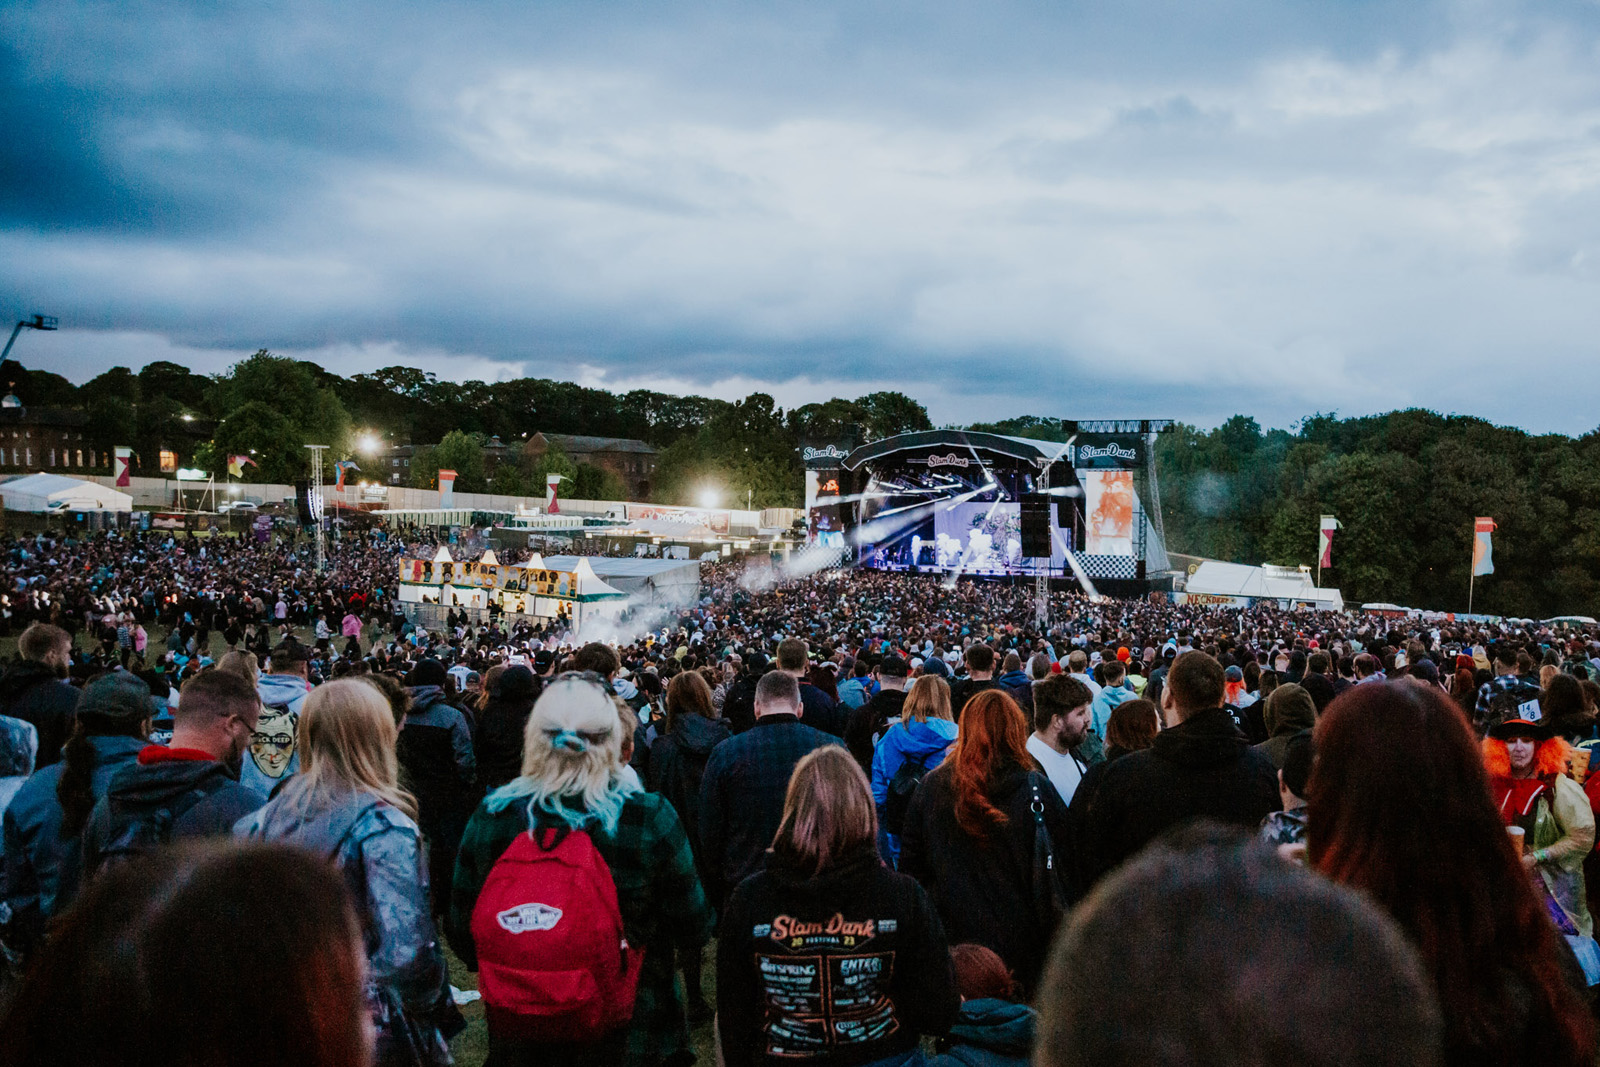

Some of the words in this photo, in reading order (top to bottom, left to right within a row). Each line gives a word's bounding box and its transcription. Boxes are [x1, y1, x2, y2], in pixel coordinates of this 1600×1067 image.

[771, 914, 822, 940] Slam
[825, 912, 876, 938] Dunk
[805, 936, 839, 944] FESTIVAL
